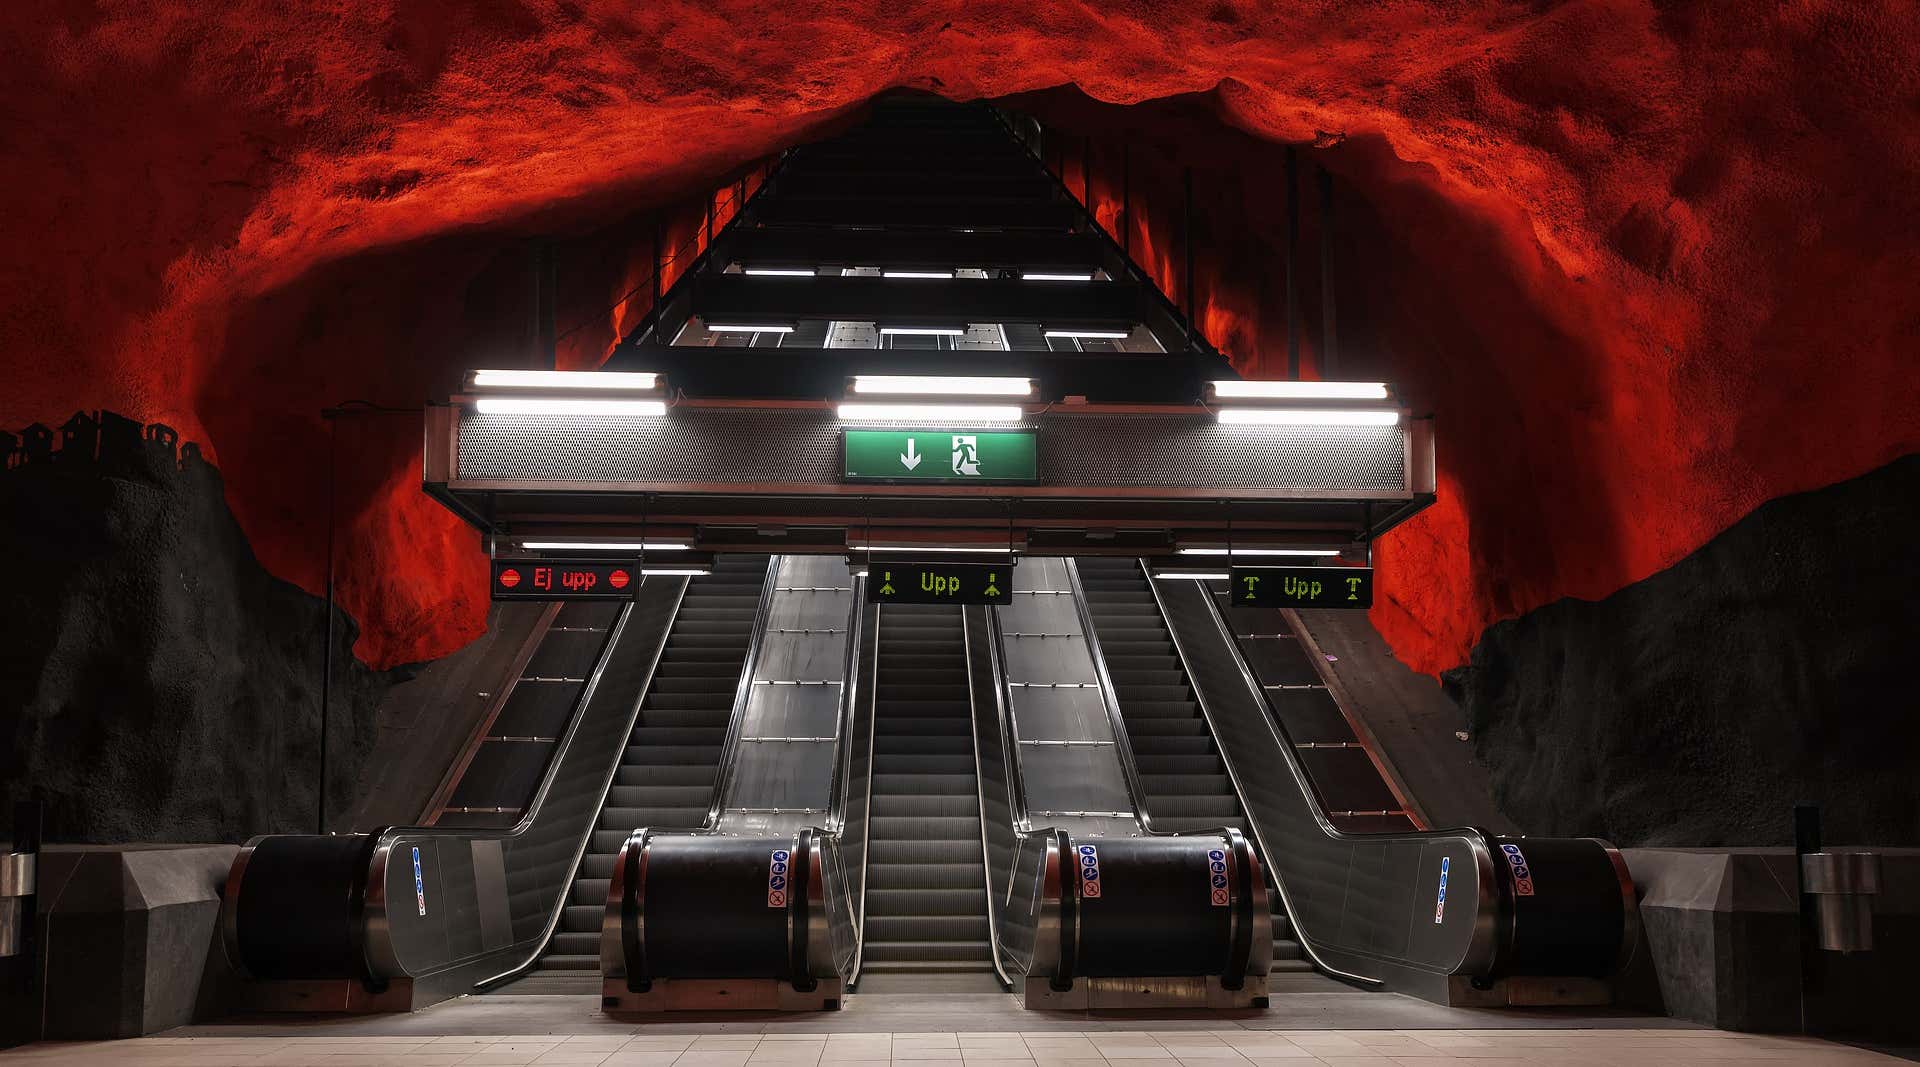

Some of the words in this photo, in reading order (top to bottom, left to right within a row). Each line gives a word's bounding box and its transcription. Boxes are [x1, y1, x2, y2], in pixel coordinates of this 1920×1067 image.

[534, 568, 552, 591] Ej
[562, 572, 597, 591] upp
[921, 572, 960, 595] Upp
[1284, 577, 1321, 599] Upp
